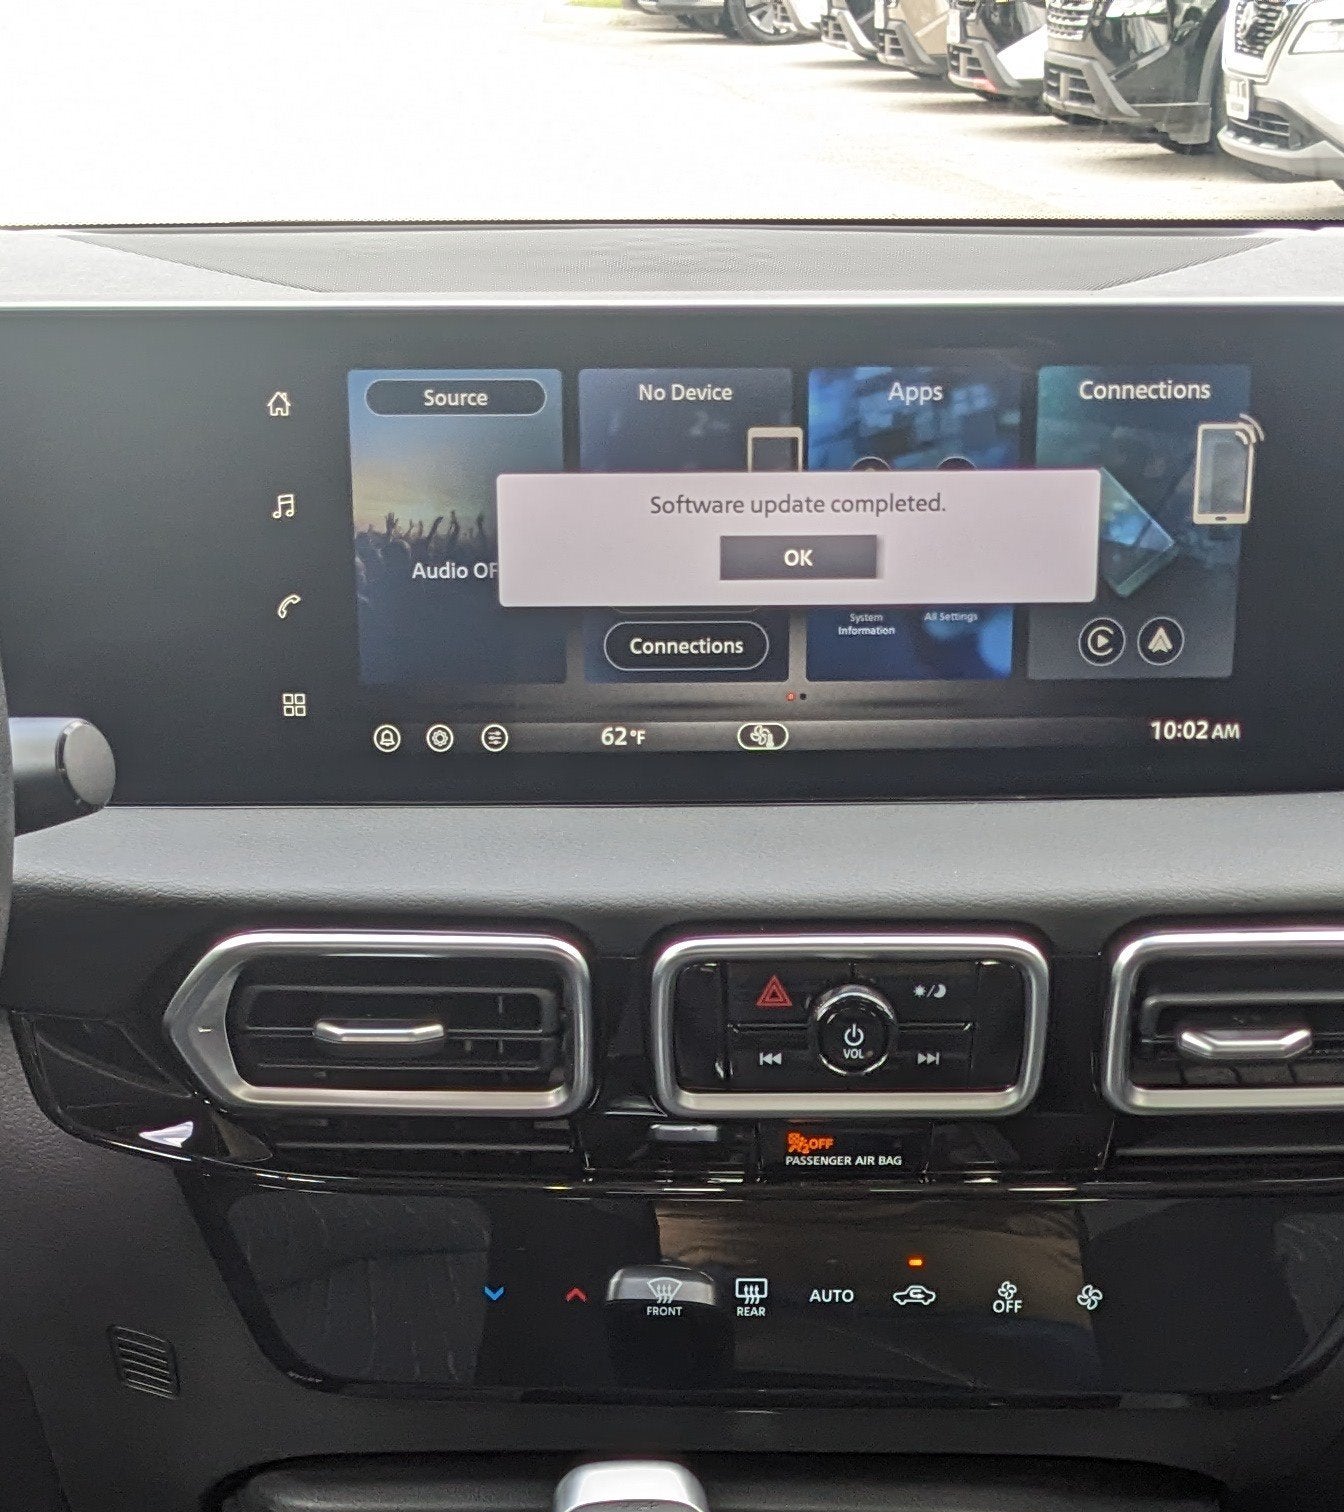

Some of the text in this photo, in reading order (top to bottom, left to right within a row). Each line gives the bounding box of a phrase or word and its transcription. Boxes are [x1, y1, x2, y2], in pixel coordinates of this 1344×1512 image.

[639, 384, 732, 401] No Device
[889, 382, 943, 403] Apps
[1080, 381, 1211, 400] Connections
[424, 390, 488, 406] Source
[650, 494, 946, 518] Software update completed.
[784, 549, 813, 566] OK
[412, 562, 468, 578] Audio
[850, 614, 883, 623] System
[924, 613, 978, 622] All Settings
[838, 626, 896, 635] Information
[630, 638, 744, 654] Connections
[843, 1049, 864, 1058] VOL
[809, 1138, 833, 1149] OFF
[786, 1156, 902, 1165] PASSENGER AIR BAG
[810, 1289, 854, 1303] AUTO
[646, 1306, 682, 1316] FRONT
[736, 1307, 766, 1317] REAR
[992, 1300, 1021, 1314] OFF
